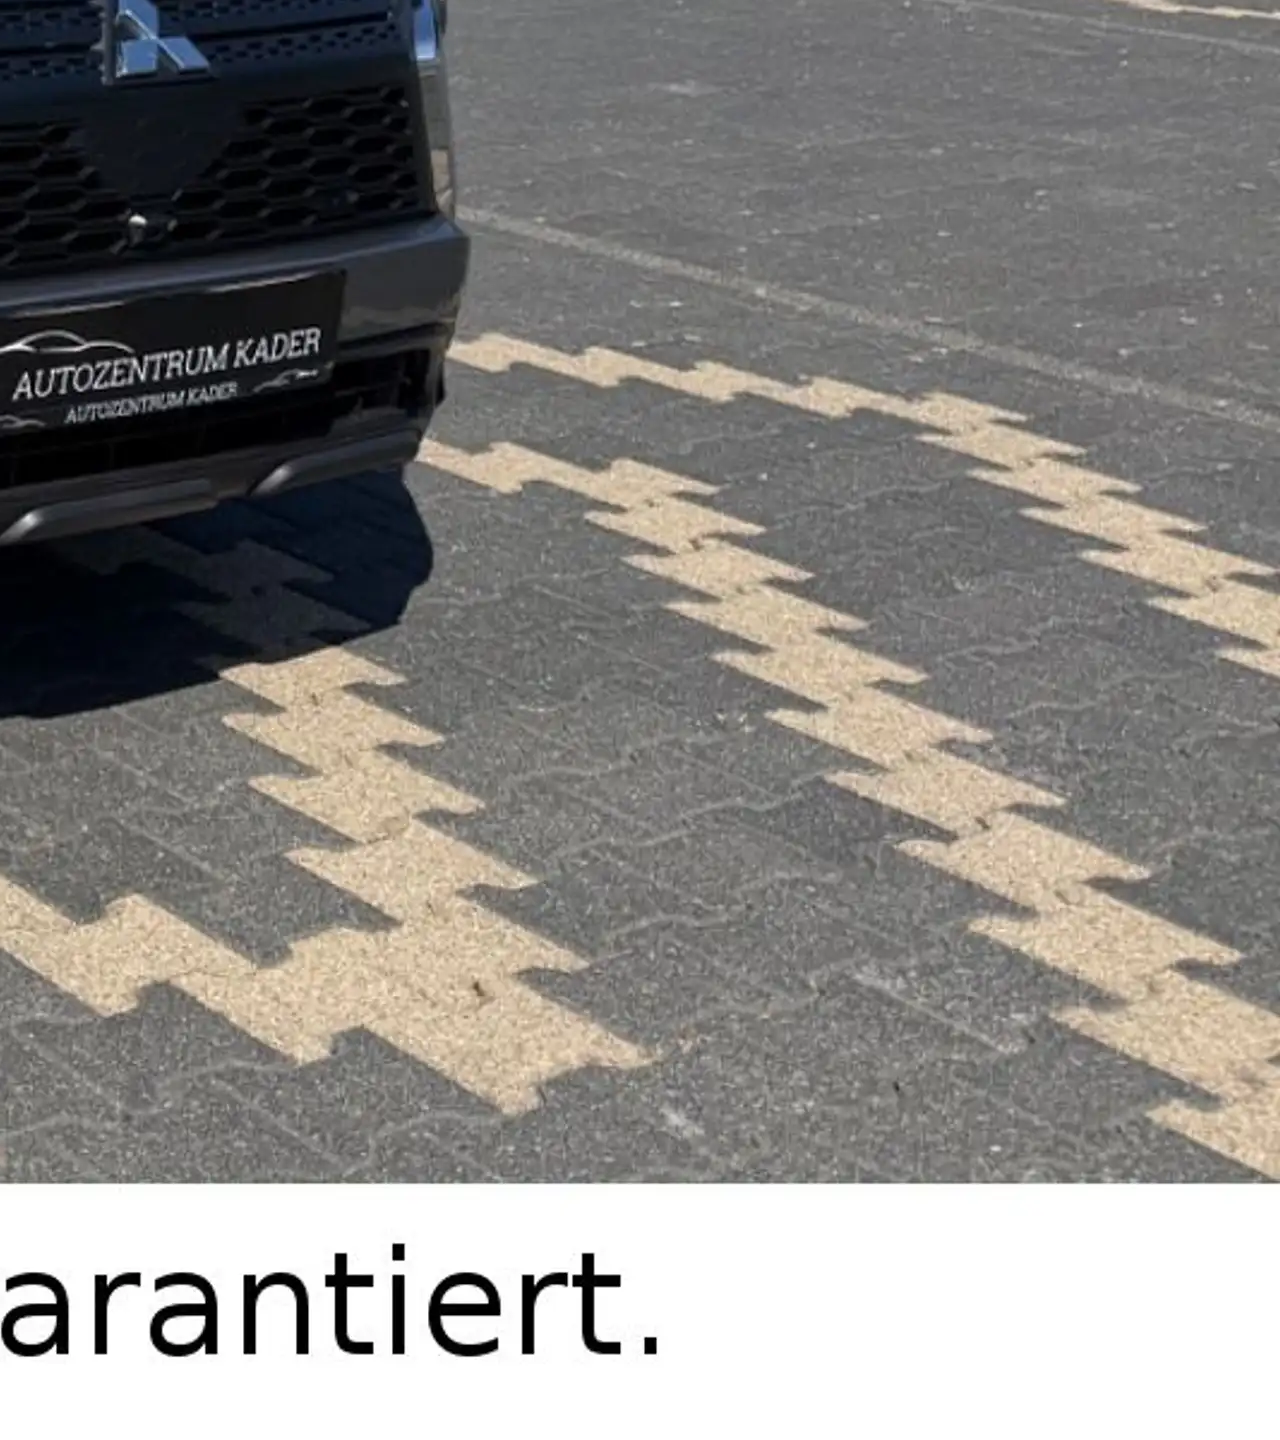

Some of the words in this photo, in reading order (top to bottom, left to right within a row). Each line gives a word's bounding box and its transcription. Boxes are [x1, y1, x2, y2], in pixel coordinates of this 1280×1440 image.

[11, 343, 230, 402] AUTOZENTRUM
[231, 326, 322, 369] KADER
[64, 390, 186, 425] AUTOZENTRUM
[184, 382, 239, 407] KADER
